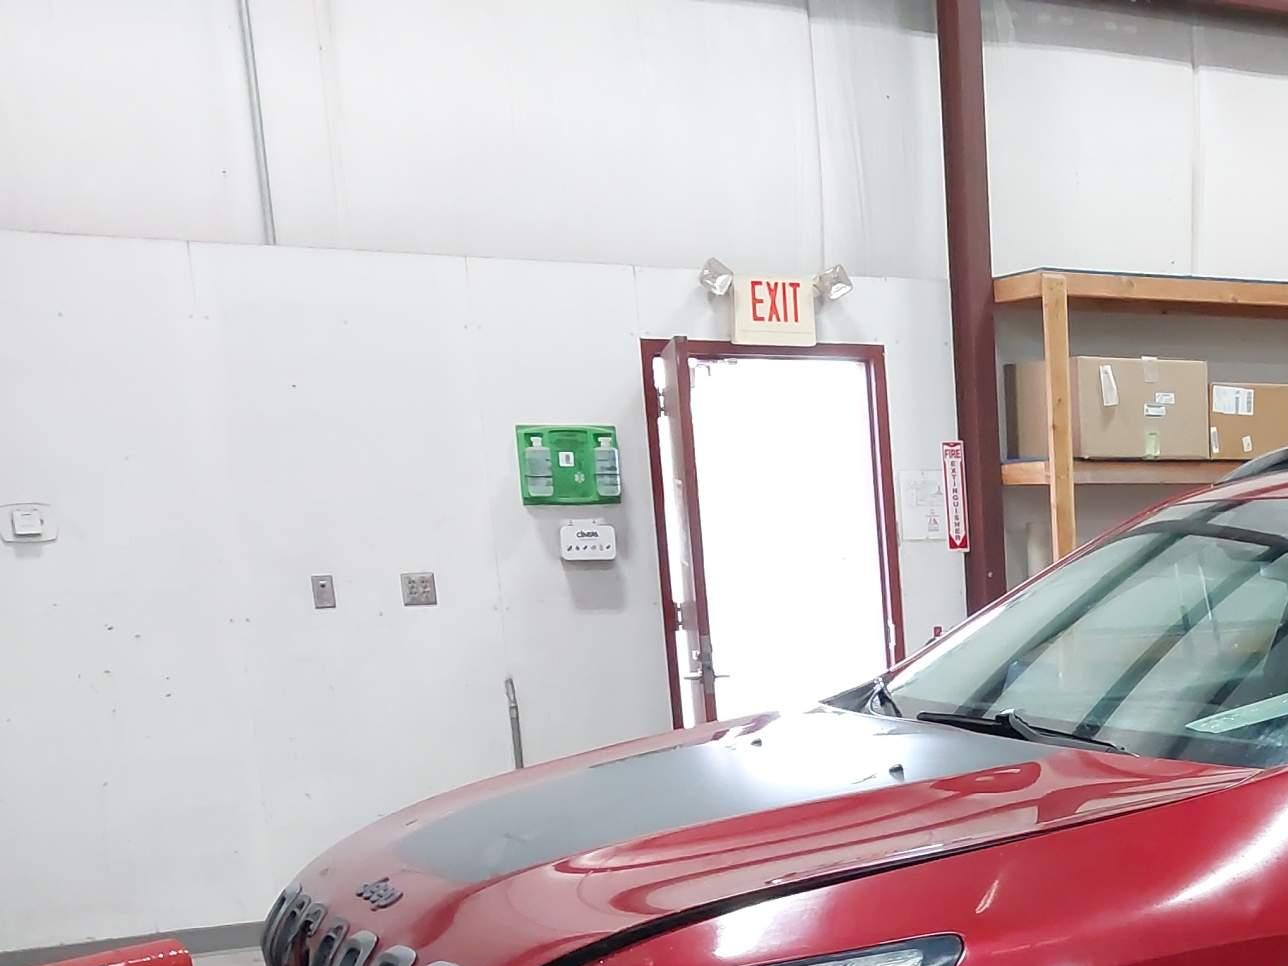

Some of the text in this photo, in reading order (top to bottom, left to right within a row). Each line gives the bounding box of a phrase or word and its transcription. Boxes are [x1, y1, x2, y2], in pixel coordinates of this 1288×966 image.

[751, 281, 800, 322] EXIT
[944, 450, 961, 459] FIRE
[950, 460, 961, 541] EXTINGUISHER
